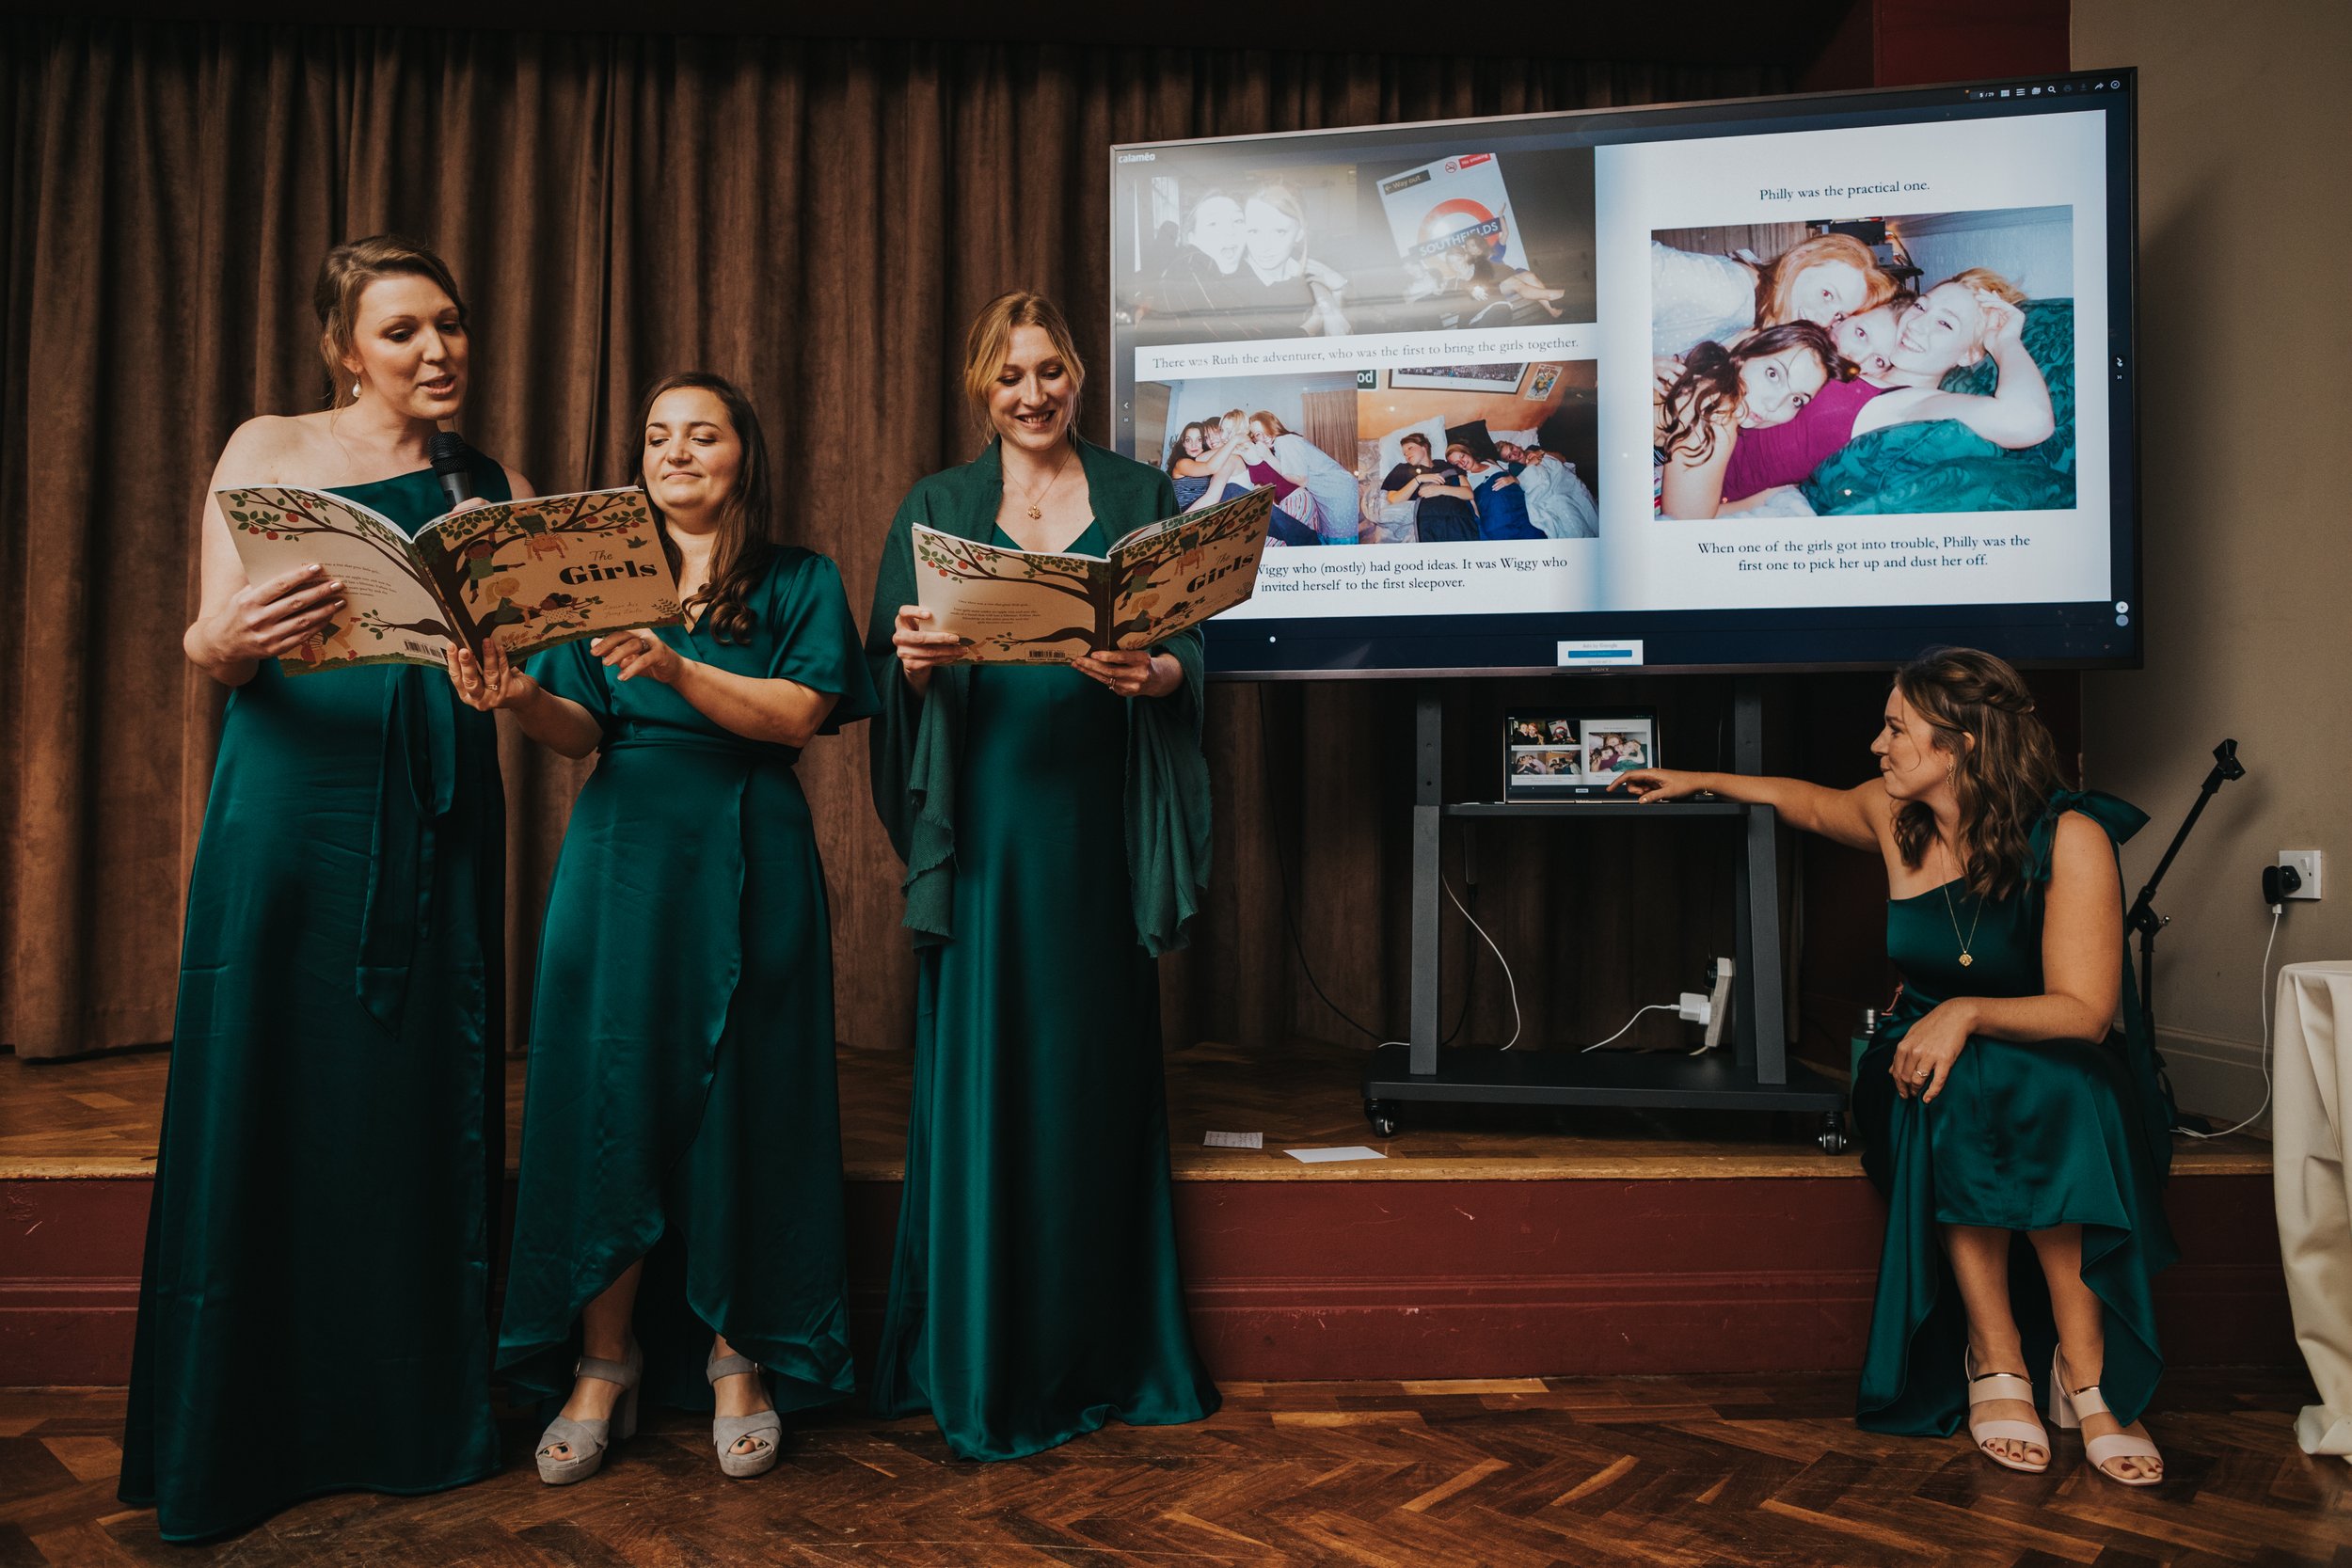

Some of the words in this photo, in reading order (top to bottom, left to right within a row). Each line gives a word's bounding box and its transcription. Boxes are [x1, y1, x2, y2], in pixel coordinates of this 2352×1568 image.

[1392, 180, 1407, 189] Way
[1409, 175, 1422, 183] out
[1760, 188, 1793, 202] Philly
[1824, 185, 1844, 197] the
[1848, 182, 1899, 198] practical
[1903, 182, 1931, 191] one.
[1152, 356, 1185, 369] There
[1212, 354, 1238, 366] Ruth
[1243, 353, 1260, 364] the
[1263, 350, 1326, 363] adventurer,
[1328, 348, 1353, 359] who
[1357, 349, 1377, 357] was
[1381, 346, 1399, 356] the
[1403, 344, 1425, 356] first
[1429, 345, 1440, 355] to
[1444, 342, 1475, 356] bring
[1478, 341, 1496, 352] the
[1499, 340, 1523, 354] girls
[1528, 338, 1579, 353] together.
[1697, 542, 1734, 554] When
[1738, 545, 1761, 553] one
[1765, 540, 1780, 552] of
[1784, 541, 1804, 552] the
[1806, 540, 1833, 555] girls
[1836, 541, 1857, 554] got
[1862, 539, 1886, 550] into
[1890, 537, 1939, 550] trouble,
[1944, 535, 1979, 550] Philly
[1982, 538, 2006, 546] was
[2010, 534, 2030, 546] the
[589, 550, 613, 561] The
[1216, 553, 1231, 564] The
[1739, 560, 1762, 571] first
[1766, 562, 1788, 571] one
[1793, 561, 1805, 570] to
[1810, 558, 1836, 573] pick
[1839, 558, 1860, 569] her
[1864, 560, 1880, 572] up
[1883, 556, 1906, 568] and
[1910, 555, 1936, 567] dust
[1942, 555, 1963, 566] her
[1965, 553, 1988, 565] off.
[559, 560, 658, 585] Girls
[1186, 554, 1254, 593] Girls
[1293, 562, 1317, 574] who
[1320, 562, 1366, 576] (mostly)
[1370, 561, 1391, 573] had
[1393, 560, 1423, 574] good
[1427, 559, 1458, 571] ideas.
[1463, 559, 1471, 569] It
[1501, 557, 1538, 572] Wiggy
[1541, 556, 1567, 567] who
[1261, 580, 1299, 593] invited
[1302, 579, 1341, 592] herself
[1345, 581, 1358, 591] to
[1361, 578, 1379, 590] the
[1383, 578, 1405, 589] first
[1408, 578, 1465, 592] sleepover.
